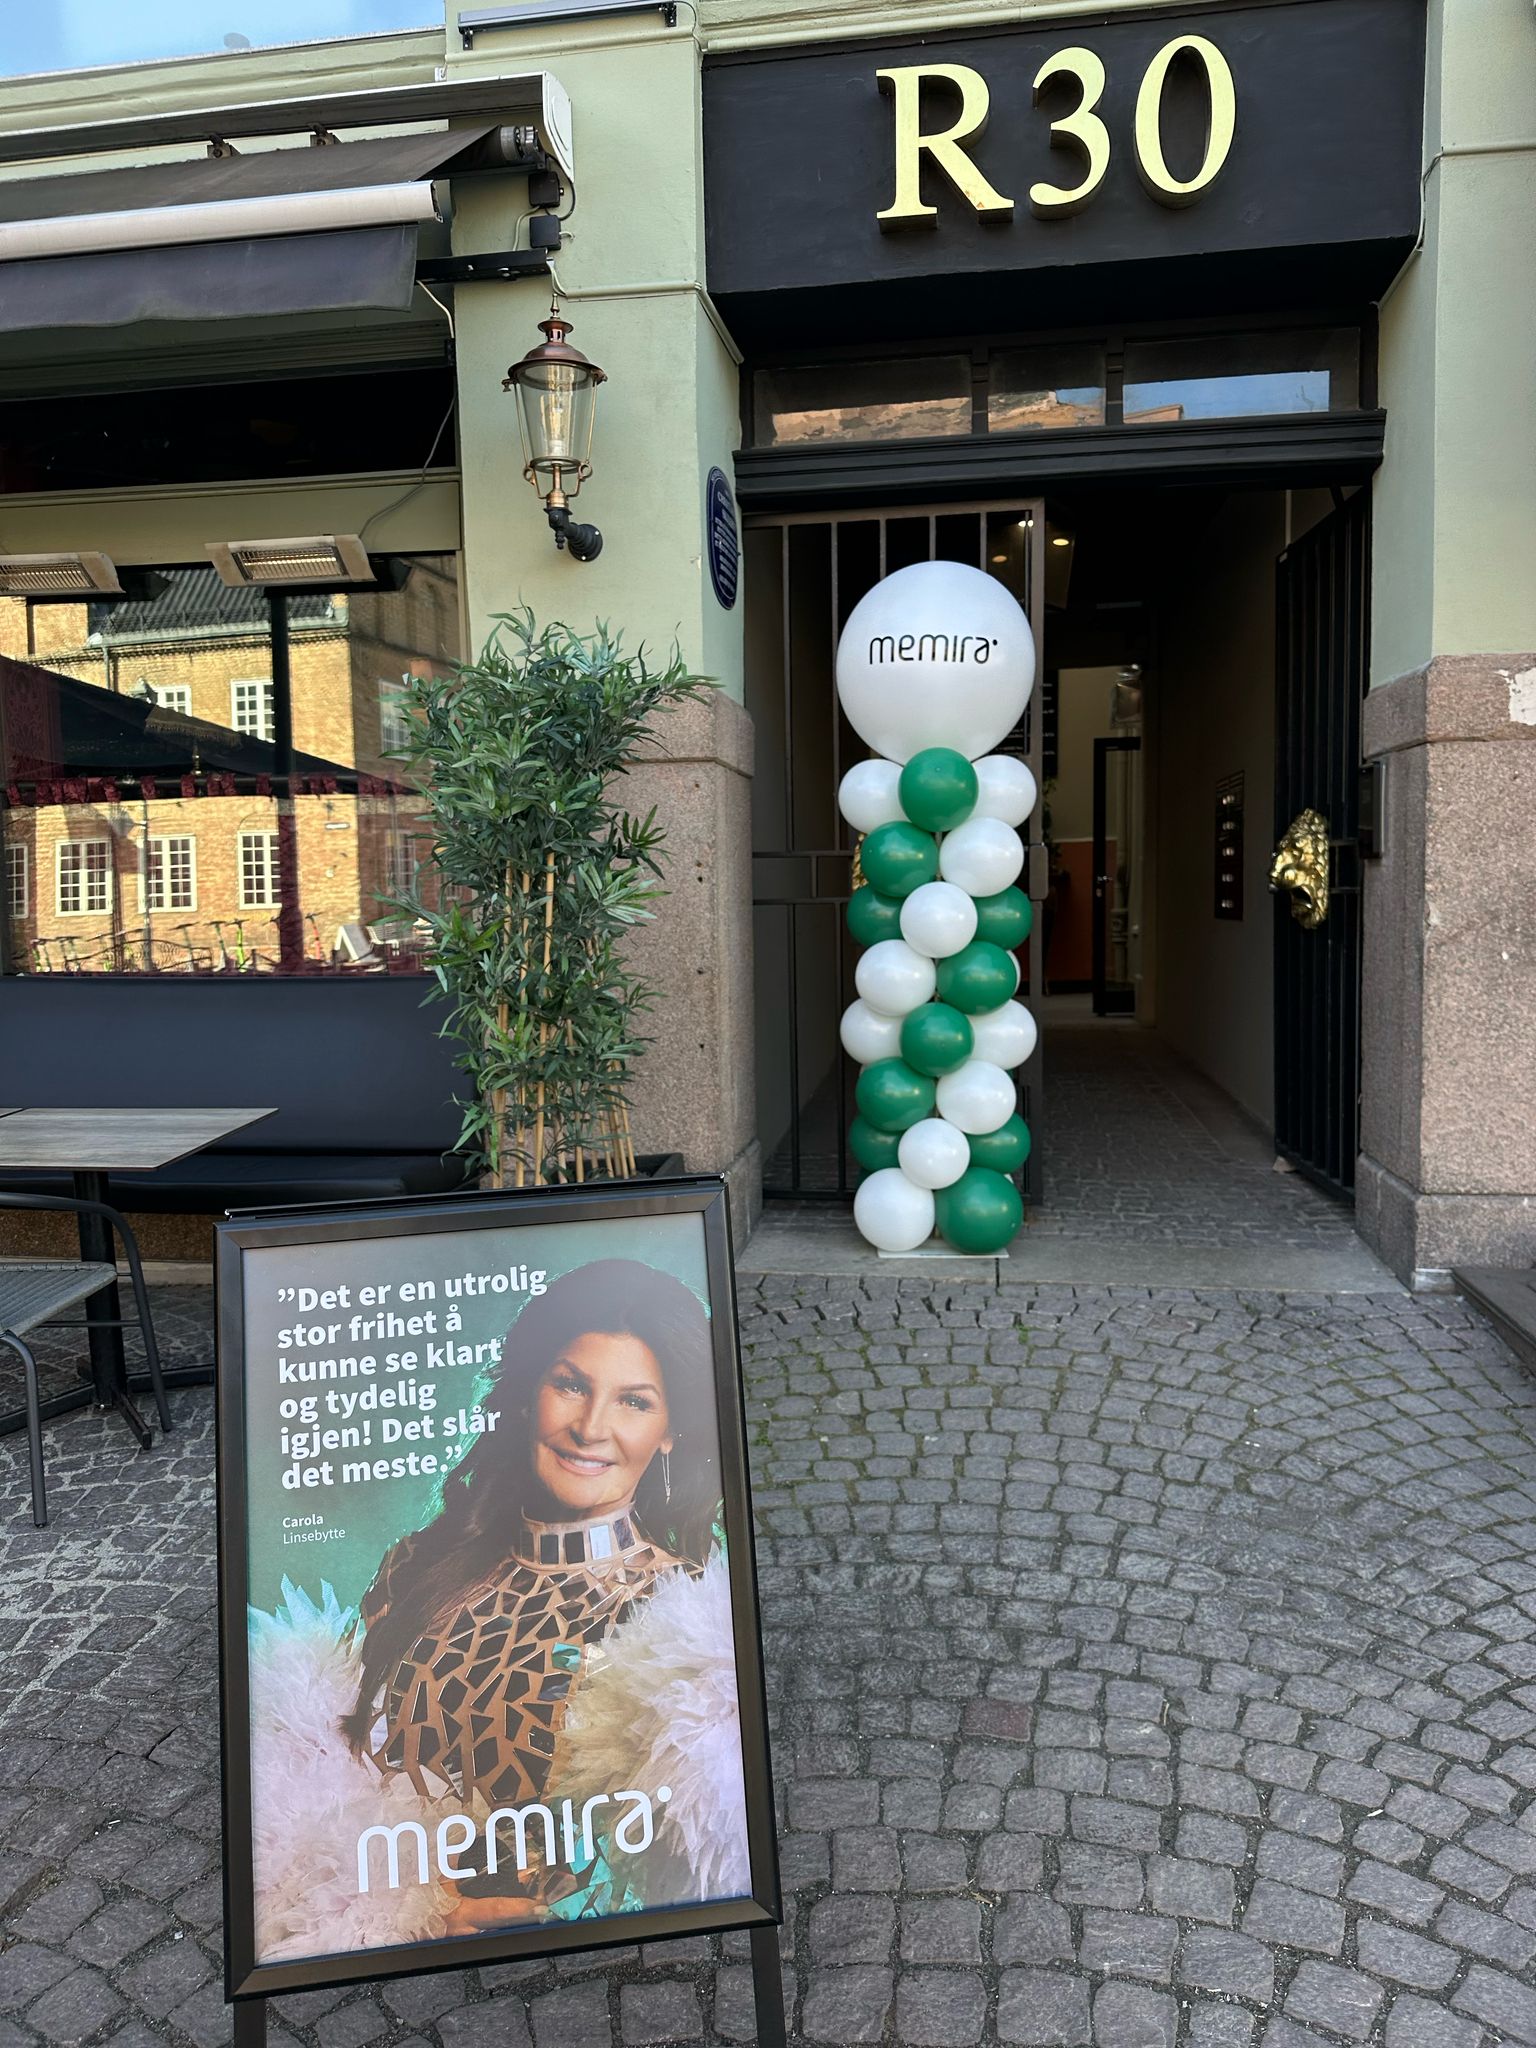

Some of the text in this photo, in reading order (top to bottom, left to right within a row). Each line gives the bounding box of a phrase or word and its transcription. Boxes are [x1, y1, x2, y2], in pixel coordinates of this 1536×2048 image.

[876, 34, 1236, 222] R30
[359, 1284, 391, 1305] er
[399, 1280, 435, 1303] en
[445, 1265, 547, 1296] utrolig
[277, 1304, 462, 1349] stor frihet å
[278, 1337, 502, 1383] kunne se klart
[279, 1379, 437, 1423] og tydelig
[280, 1405, 501, 1460] igjen! Det slår
[281, 1462, 334, 1490] det
[282, 1513, 324, 1528] Carola
[283, 1528, 346, 1545] Linsebytte
